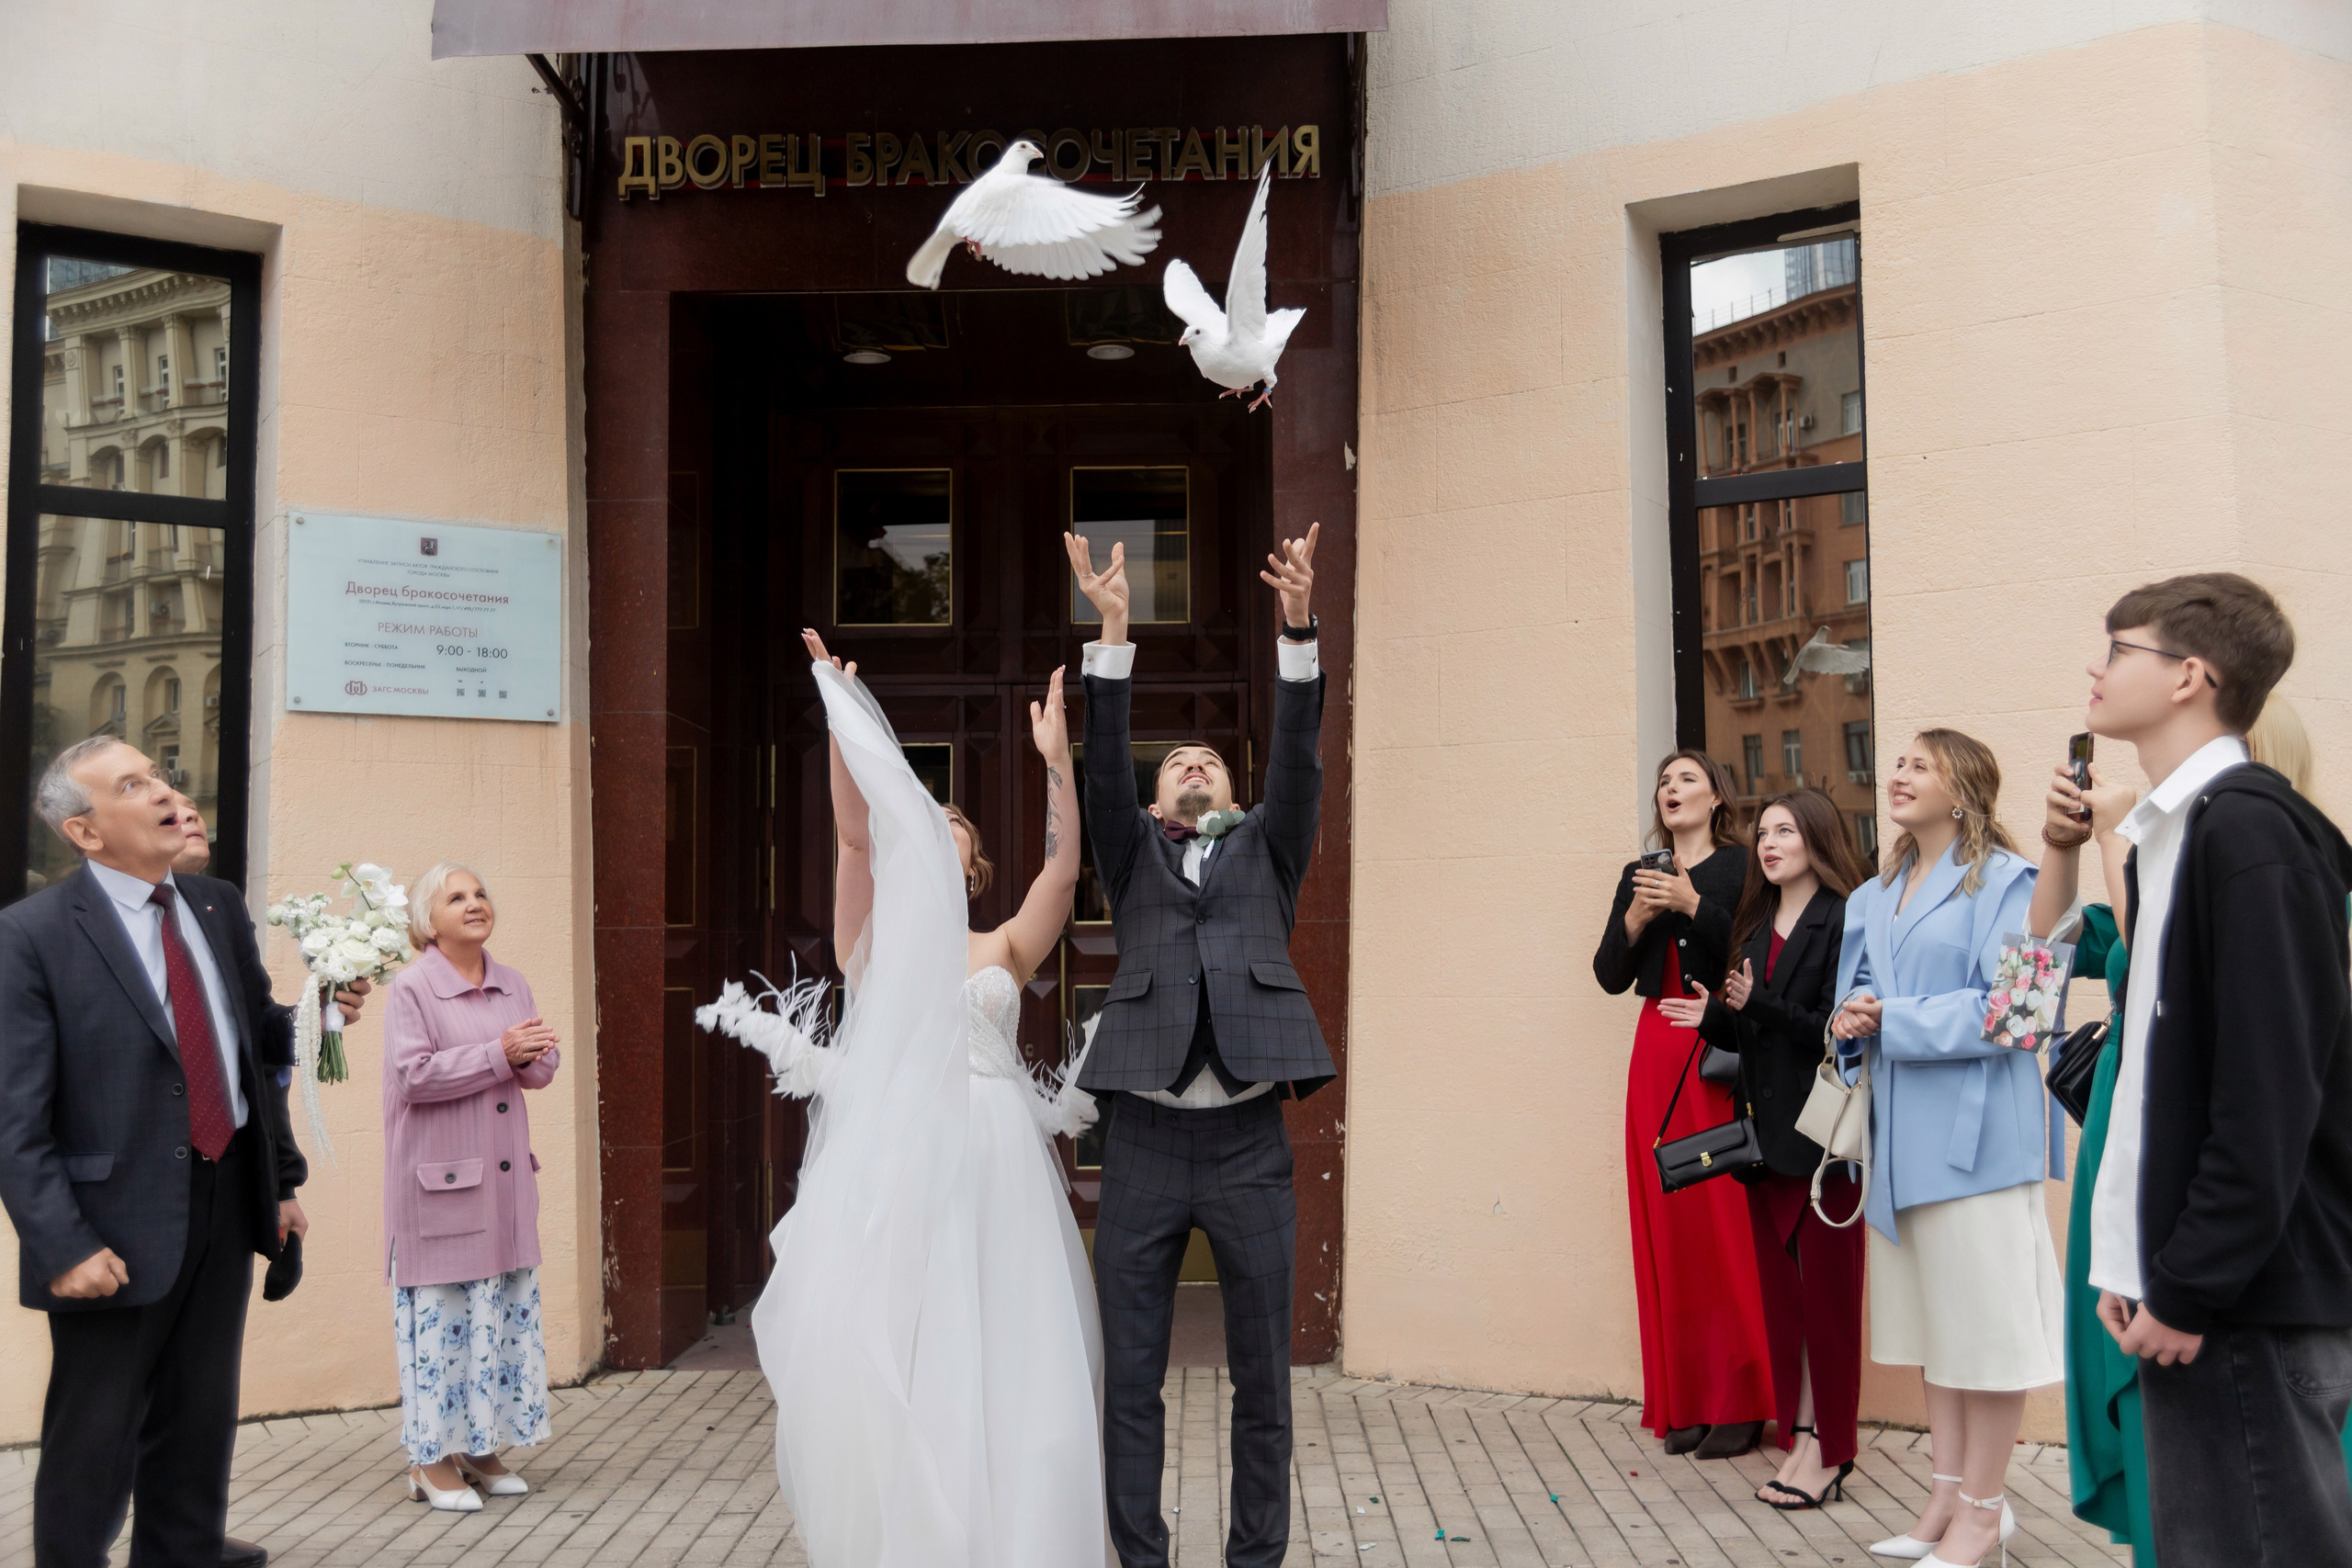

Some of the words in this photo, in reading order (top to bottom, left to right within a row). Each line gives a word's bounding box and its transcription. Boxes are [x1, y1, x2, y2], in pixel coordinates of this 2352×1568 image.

[617, 133, 826, 200] ДВОРЕЦ
[429, 564, 469, 572] ГРАЖДАНСКОГО
[345, 581, 398, 598] Дворец
[401, 585, 509, 604] бракосочетания
[378, 622, 425, 635] РЕЖИМ
[429, 625, 478, 638] РАБОТЫ
[436, 644, 464, 657] 9:00
[476, 647, 508, 659] 18:00
[372, 685, 392, 694] ЗАГС
[393, 686, 429, 694] МОСКВЫ
